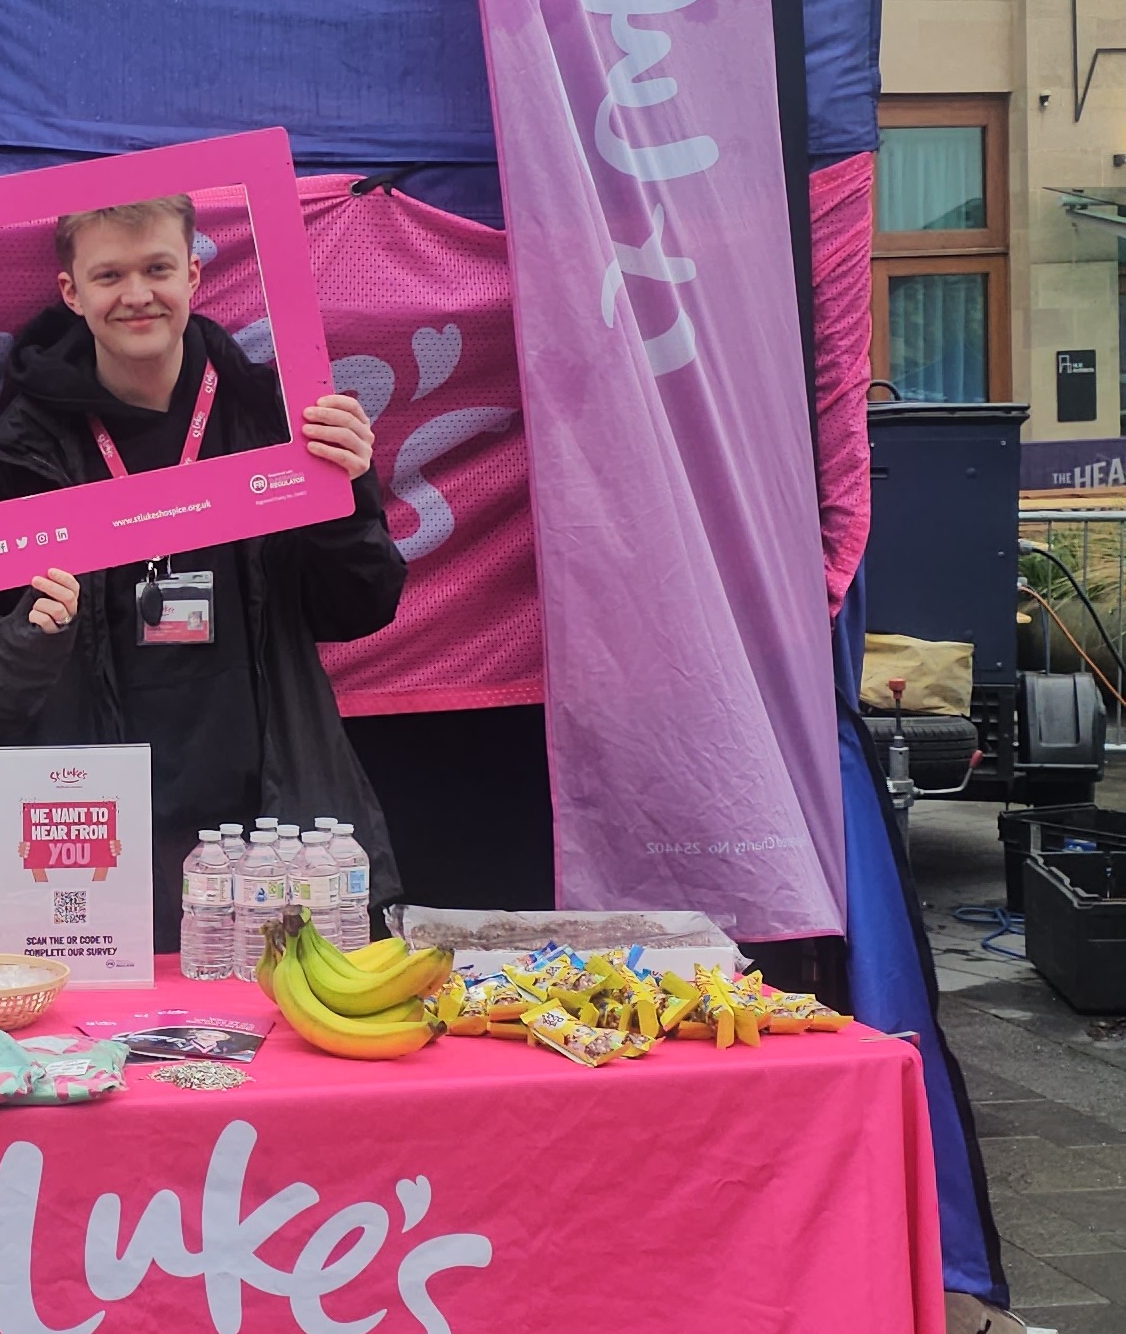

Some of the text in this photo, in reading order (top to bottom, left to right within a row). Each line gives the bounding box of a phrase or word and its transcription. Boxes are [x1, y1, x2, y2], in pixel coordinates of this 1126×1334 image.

[1052, 472, 1072, 485] THE
[112, 499, 212, 528] www.stlukeshospice.org.uk
[50, 767, 88, 783] St Luke's
[30, 807, 109, 823] WE WANT TO
[32, 825, 108, 841] HEAR FROM
[48, 843, 91, 865] YOU
[26, 937, 47, 945] SCAN
[49, 937, 64, 945] THE
[80, 935, 100, 945] CODE
[103, 935, 112, 944] TO
[24, 947, 118, 957] COMPLETE OUR SURVEY
